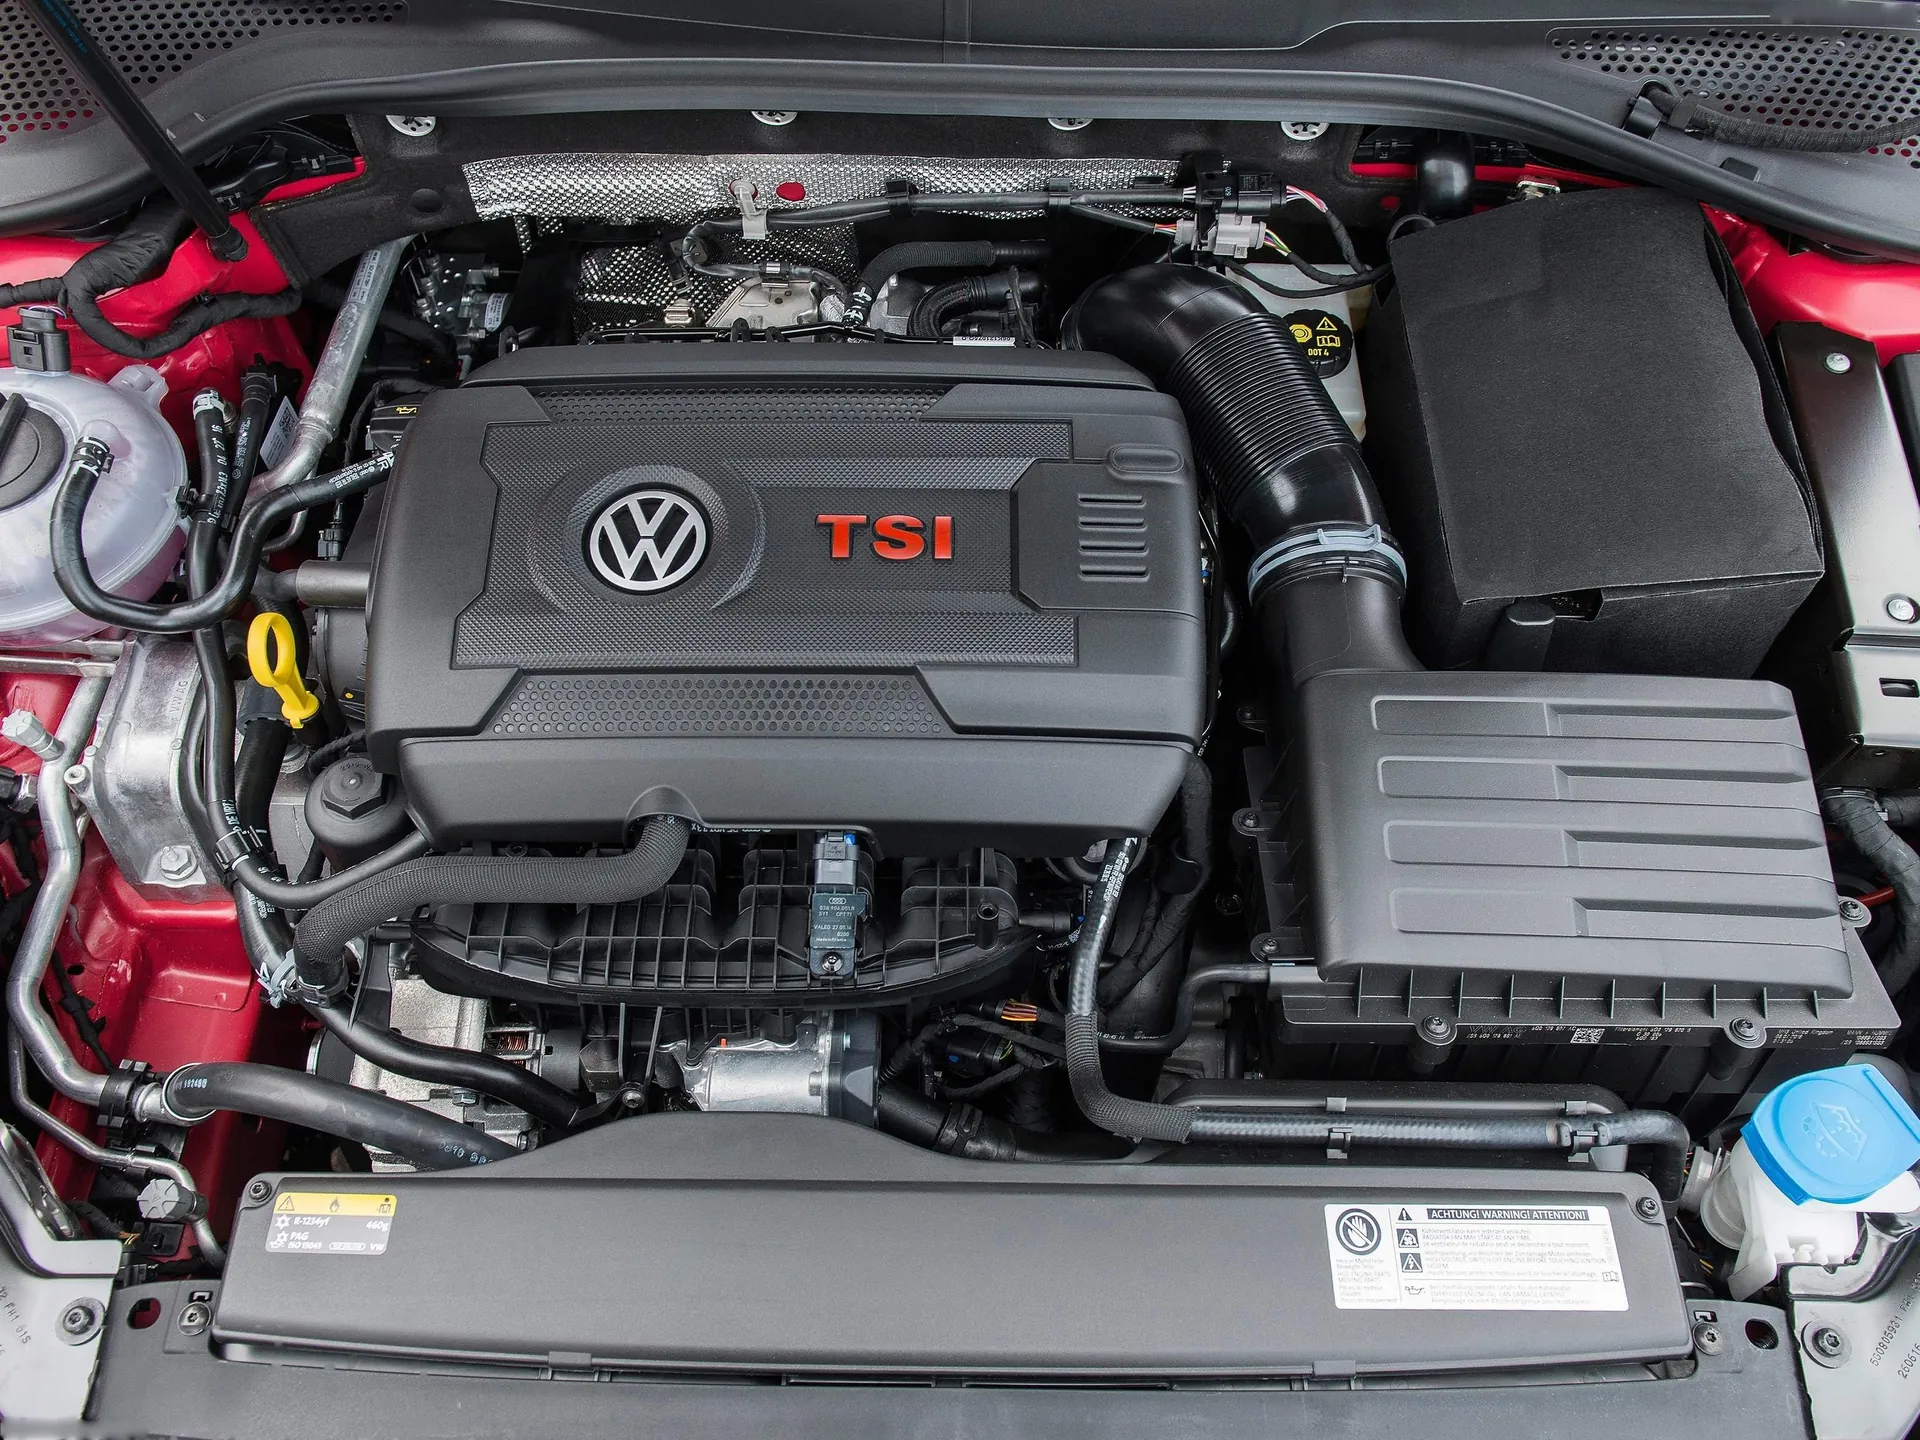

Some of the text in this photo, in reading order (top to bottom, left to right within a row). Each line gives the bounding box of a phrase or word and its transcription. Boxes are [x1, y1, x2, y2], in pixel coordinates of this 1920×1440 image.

[1308, 348, 1330, 356] DOT 4
[816, 514, 953, 560] TSI
[1431, 1209, 1586, 1220] ACHTUNG! WARNING! ATTENTION!
[293, 1216, 389, 1232] R-1234yf 460g
[290, 1232, 309, 1241] PAG
[369, 1243, 385, 1251] VW
